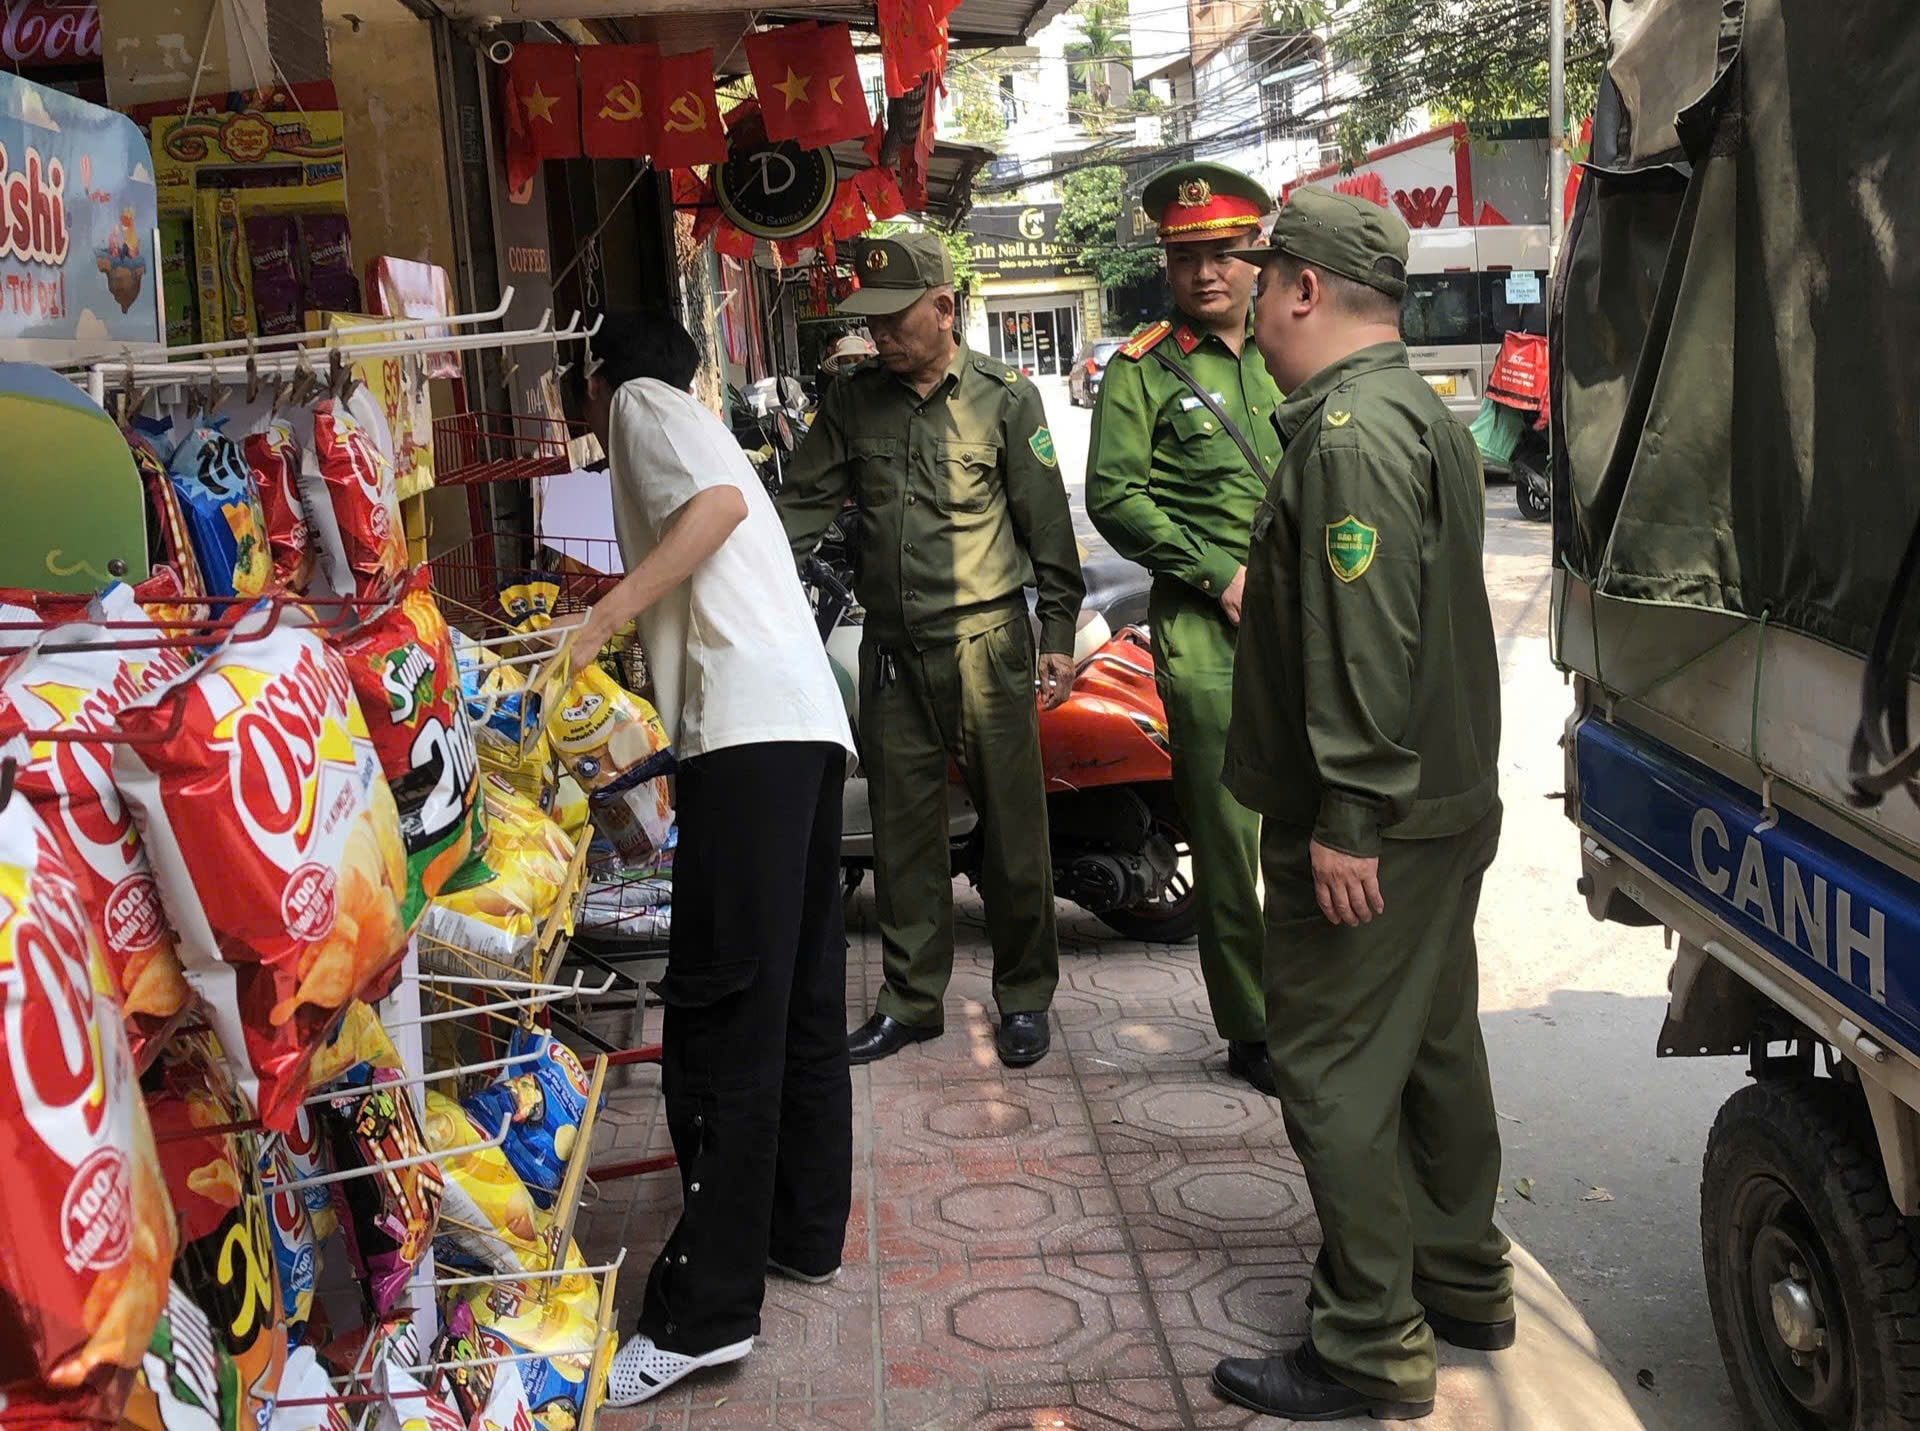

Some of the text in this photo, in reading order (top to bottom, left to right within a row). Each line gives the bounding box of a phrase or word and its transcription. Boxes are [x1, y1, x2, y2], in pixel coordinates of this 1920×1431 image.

[749, 151, 796, 196] D
[508, 246, 547, 273] COFFEE
[1028, 243, 1038, 256] &
[1690, 807, 1886, 1004] CẢNH
[107, 916, 142, 953] KHOAI
